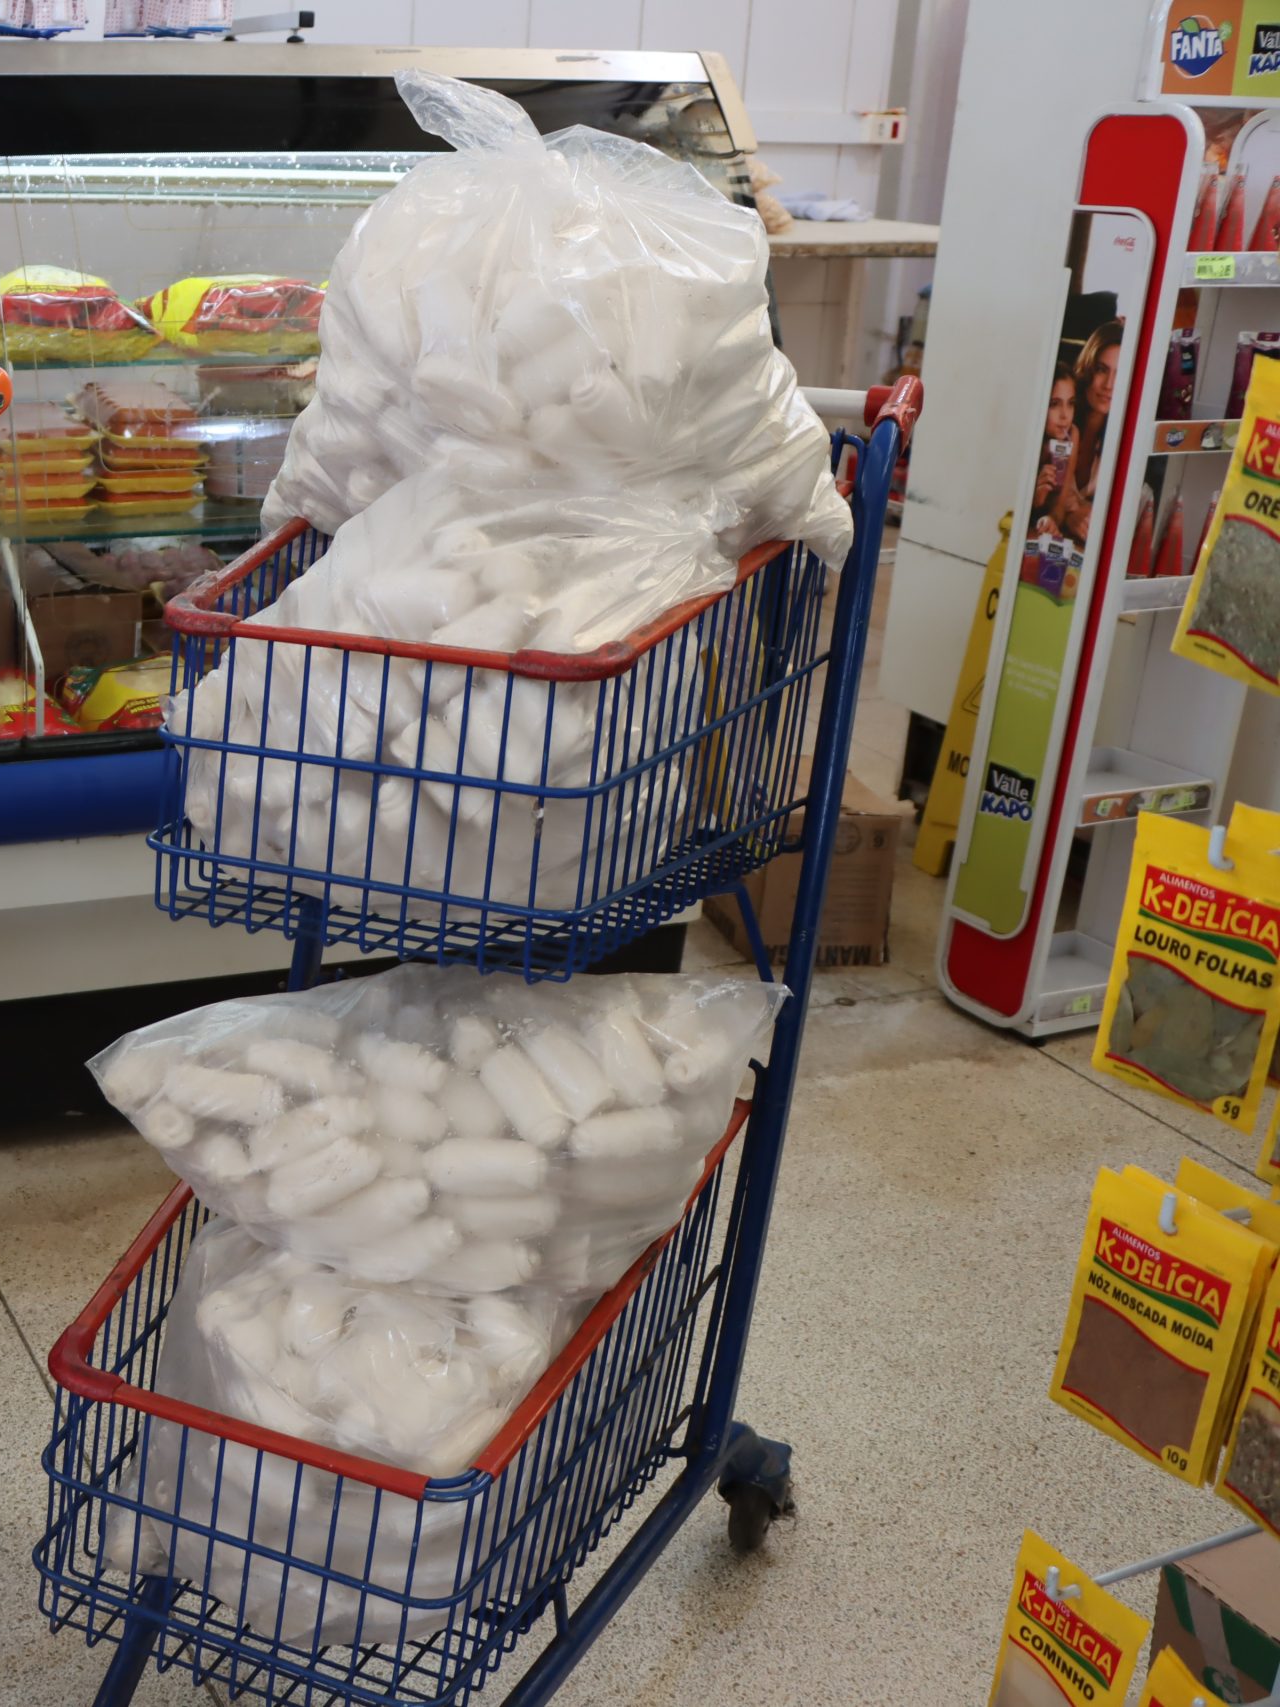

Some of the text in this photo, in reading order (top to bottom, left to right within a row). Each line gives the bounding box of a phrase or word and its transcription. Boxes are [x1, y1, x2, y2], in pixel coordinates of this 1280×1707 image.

[1171, 29, 1224, 61] FANTA
[1259, 30, 1280, 49] Val
[1248, 51, 1280, 78] KAP
[1243, 488, 1280, 520] ORE
[993, 770, 1029, 801] Valle
[980, 791, 1032, 821] KAPO
[1160, 872, 1216, 900] ALIMENTOS
[1144, 878, 1279, 949] K-DELÍCIA
[1134, 925, 1273, 989] LOURO FOLHAS
[1222, 1100, 1240, 1120] 5g
[1112, 1226, 1160, 1261] ALIMENTOS
[1098, 1230, 1220, 1316] K-DELÍCIA
[1088, 1270, 1214, 1352] NÓZ MOSCADA MOÍDA
[1167, 1447, 1188, 1471] 10g
[1034, 1580, 1071, 1618] ALITOS
[1021, 1580, 1112, 1678] K-DELÍCIA
[1020, 1624, 1095, 1701] COMINHO
